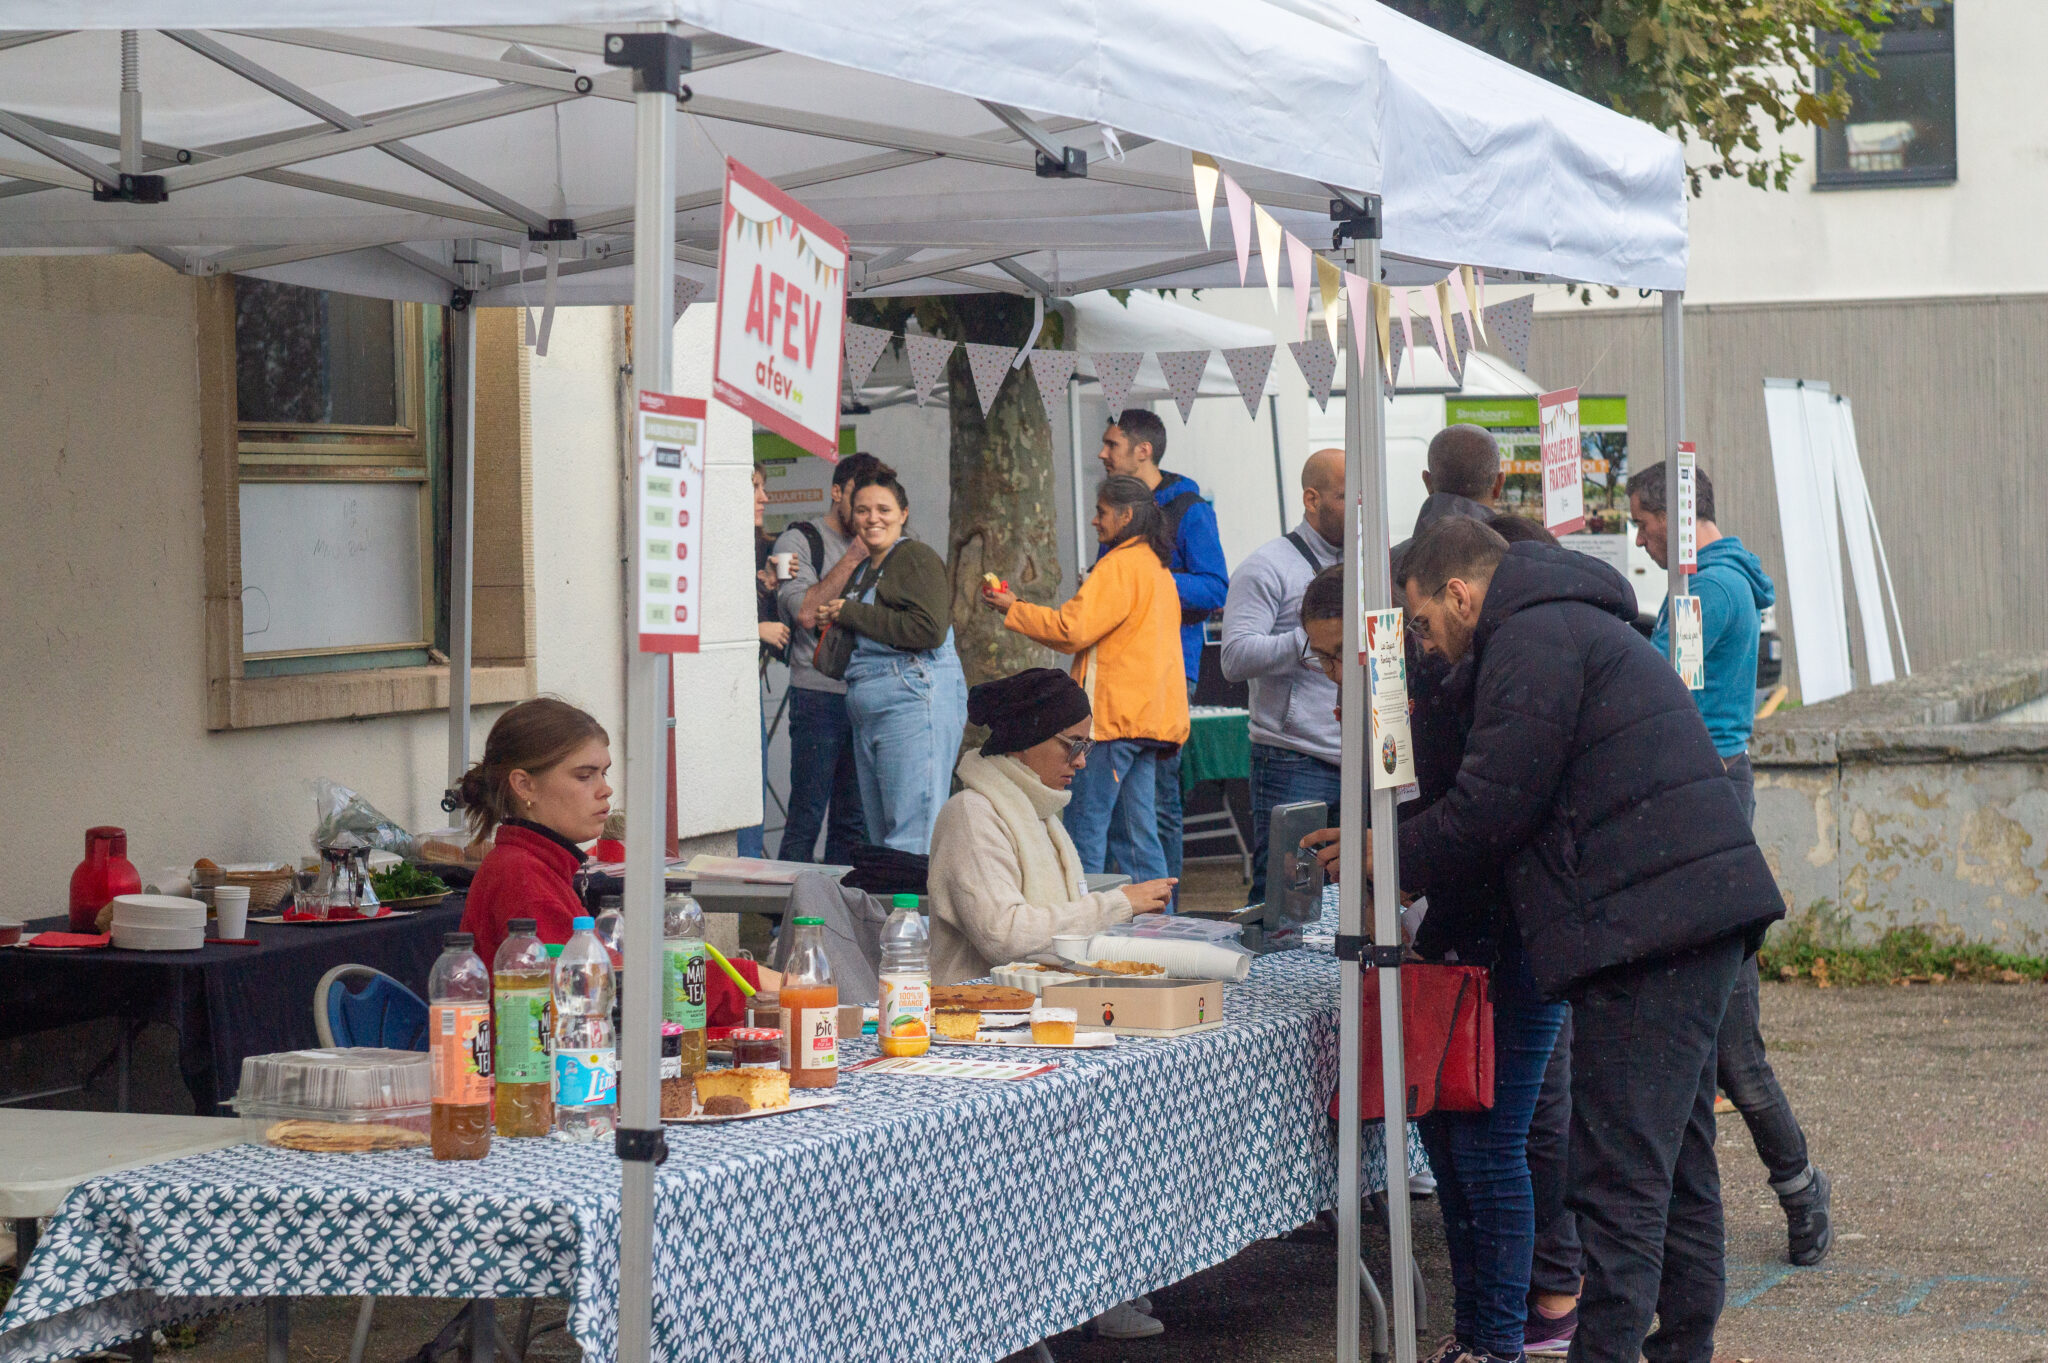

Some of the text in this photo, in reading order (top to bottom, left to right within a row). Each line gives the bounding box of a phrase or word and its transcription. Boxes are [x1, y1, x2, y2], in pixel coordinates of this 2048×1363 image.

[745, 263, 822, 370] AFEV
[756, 355, 793, 400] afev
[1567, 436, 1574, 459] DE
